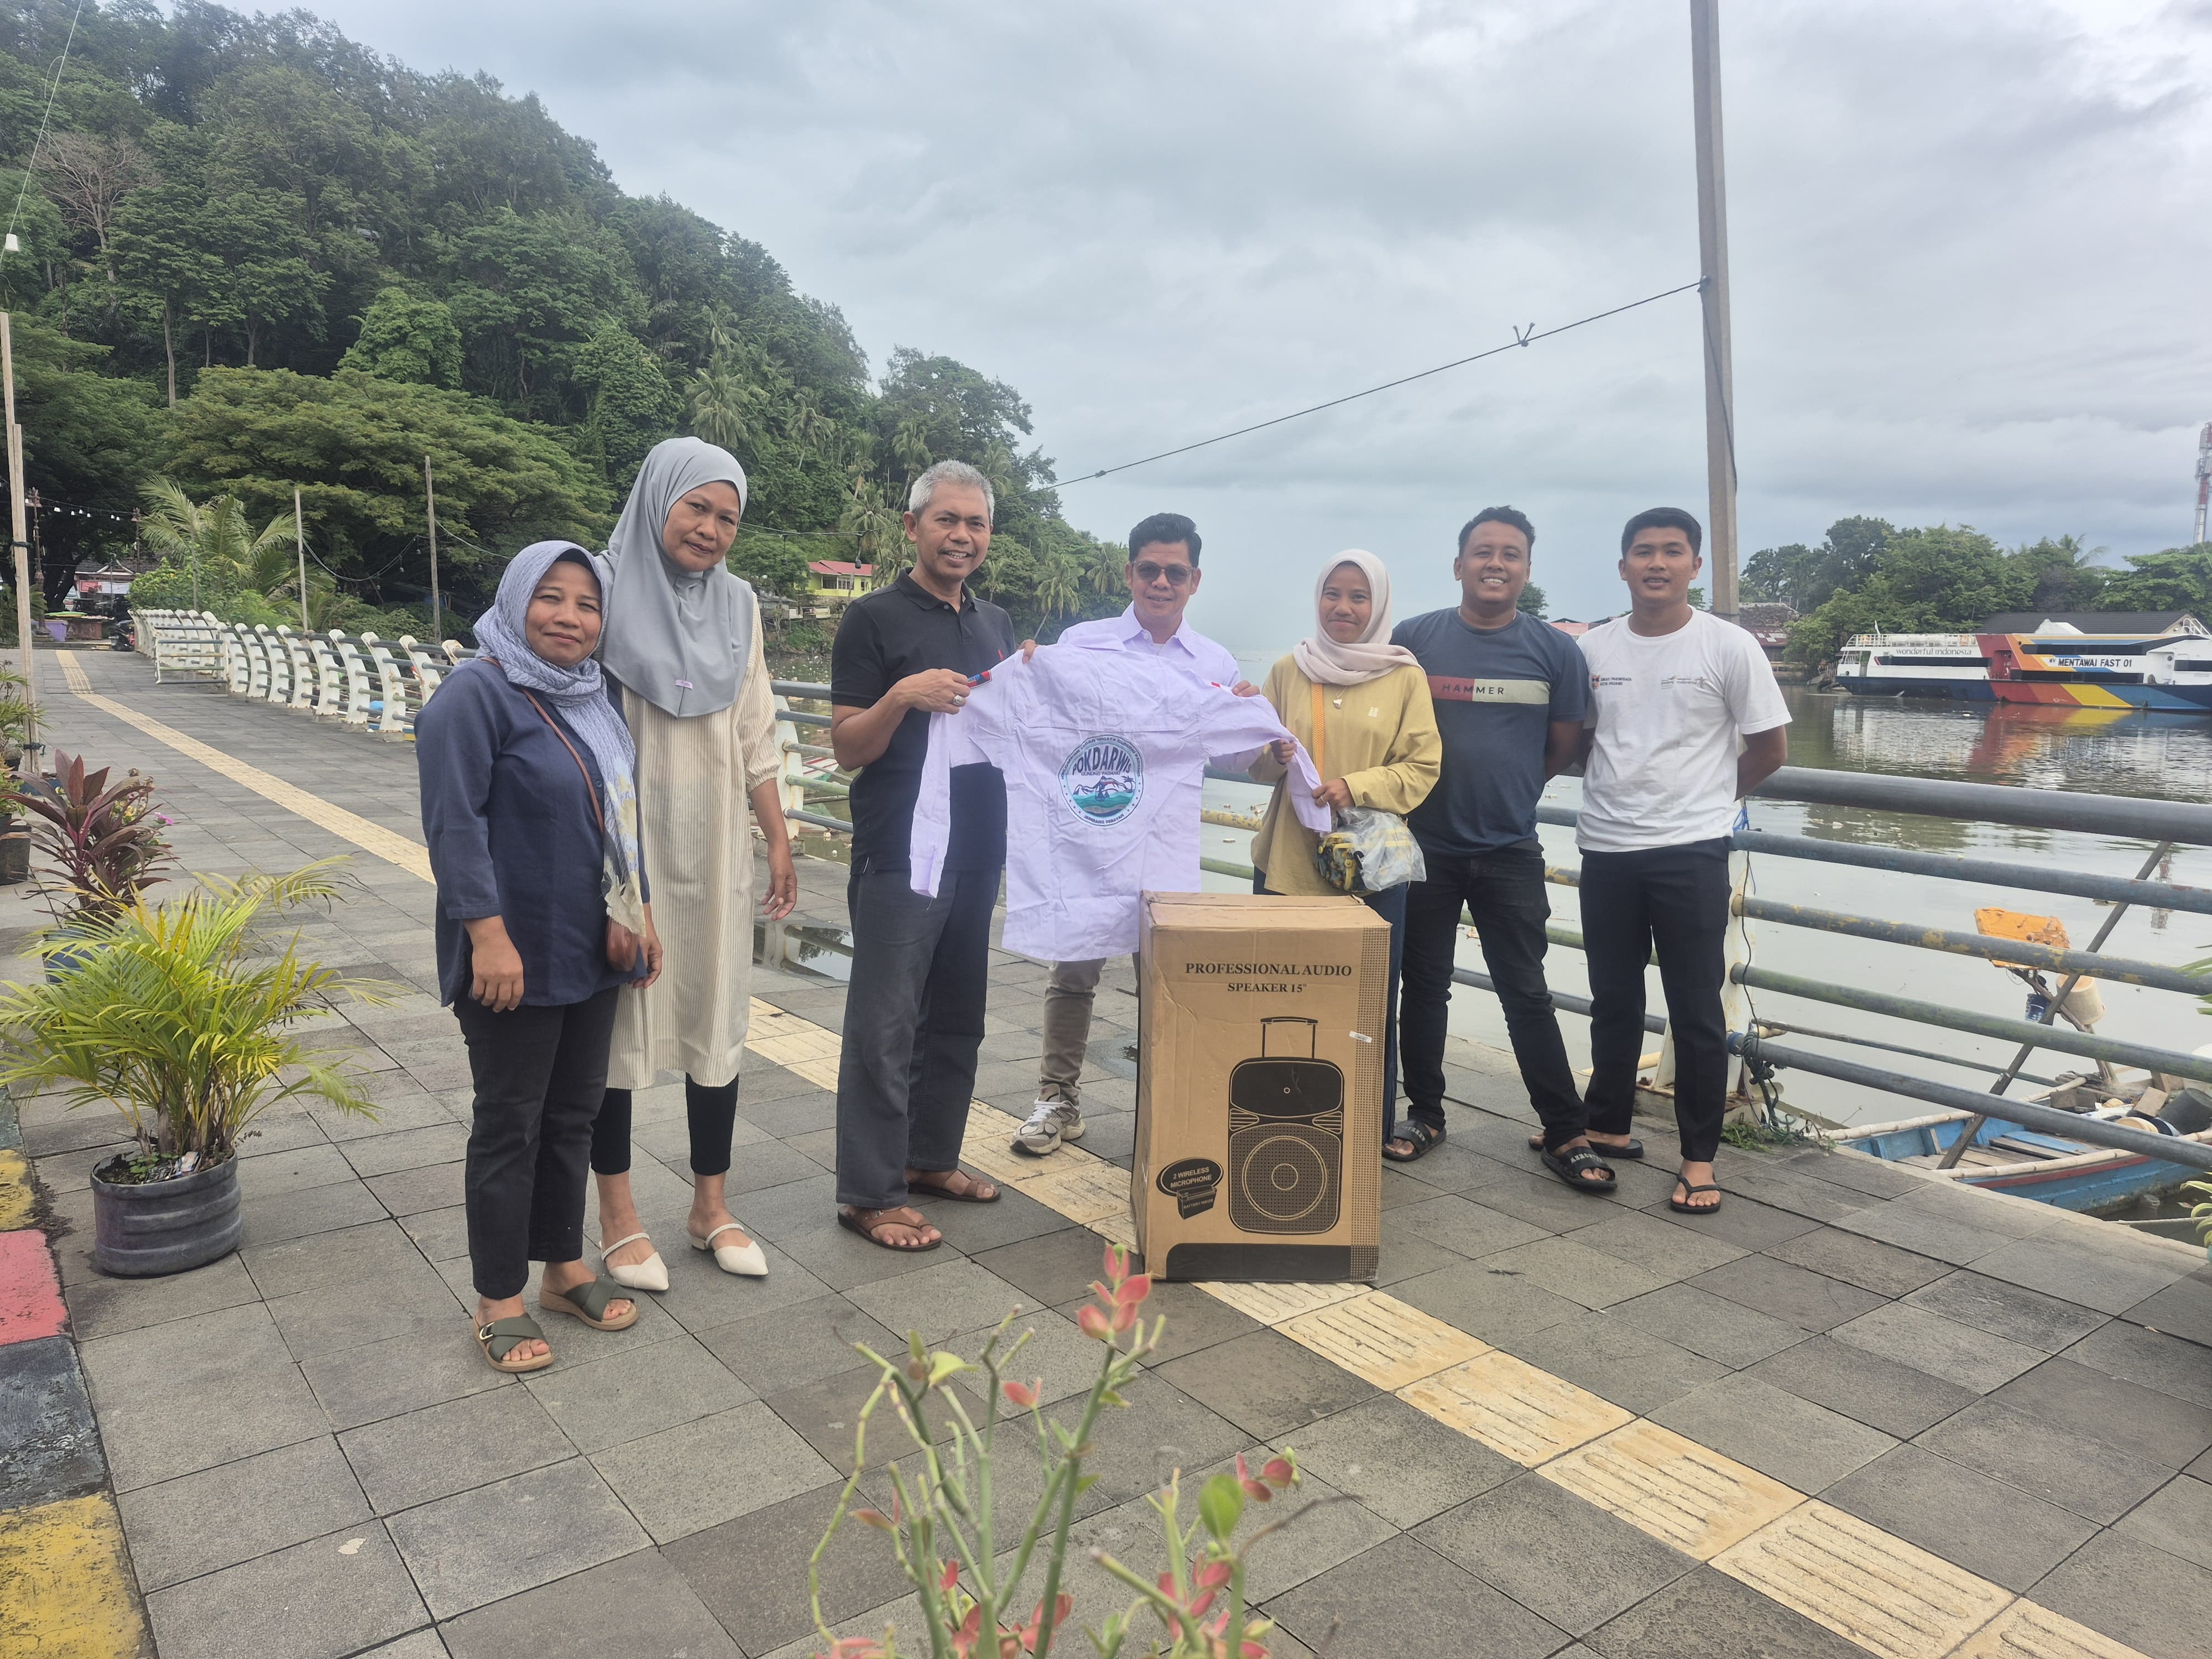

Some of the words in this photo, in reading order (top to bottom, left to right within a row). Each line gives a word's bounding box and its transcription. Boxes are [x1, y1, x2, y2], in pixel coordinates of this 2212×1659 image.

[2058, 658, 2097, 667] MENTAWAI
[2100, 659, 2121, 667] FAST
[2124, 659, 2132, 667] 01
[1442, 683, 1504, 695] HAMMER
[1072, 745, 1131, 775] POKDARWIS
[1185, 963, 1300, 975] PROFESSIONAL
[1301, 964, 1352, 976] AUDIO
[1227, 983, 1288, 992] SPEAKER
[1177, 1167, 1209, 1178] WIRELESS
[1170, 1174, 1213, 1188] MICROPHONE
